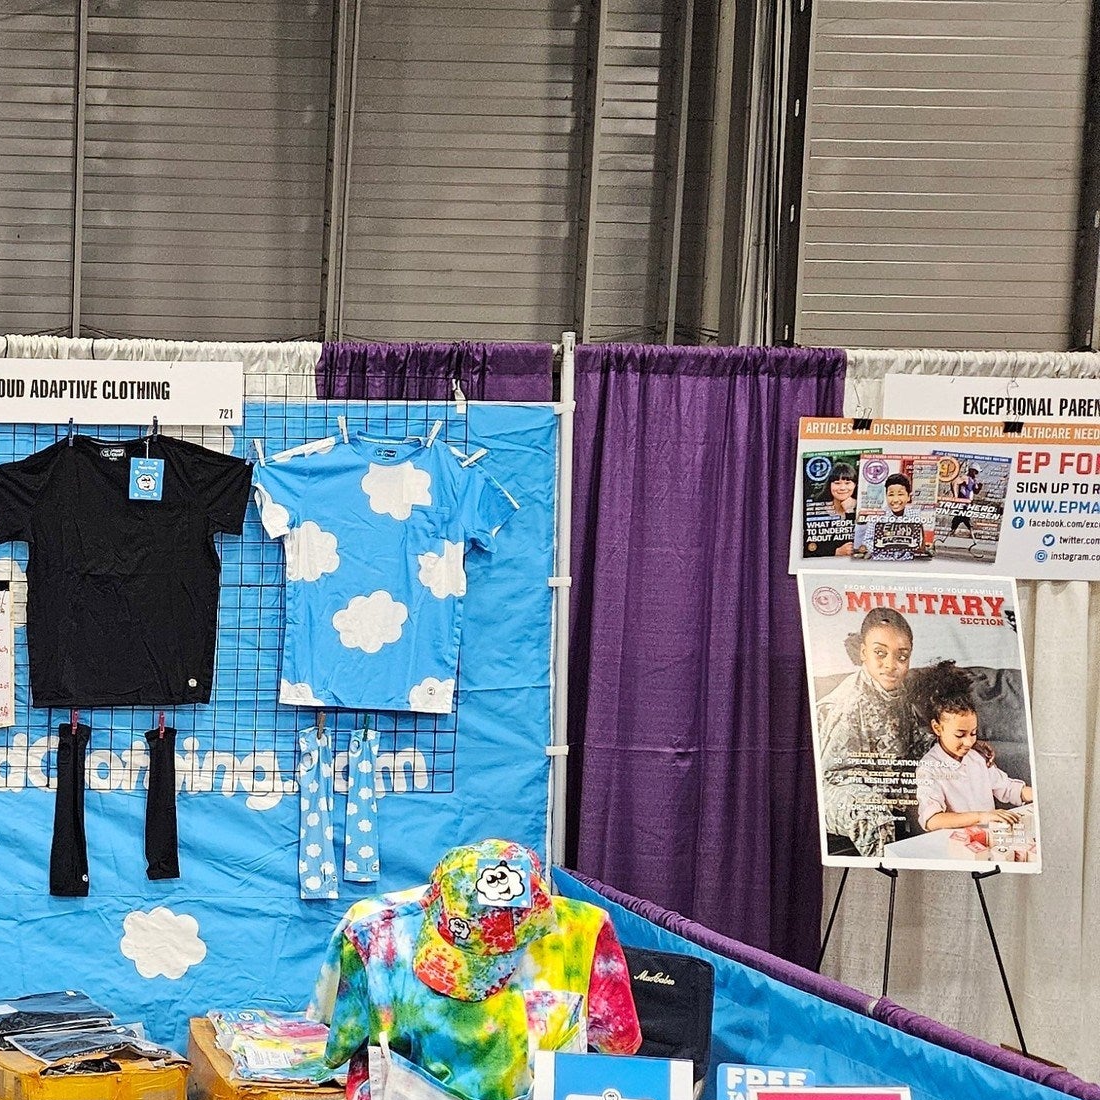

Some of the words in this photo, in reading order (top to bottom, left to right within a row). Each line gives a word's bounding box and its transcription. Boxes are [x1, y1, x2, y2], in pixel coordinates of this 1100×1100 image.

[30, 379, 98, 400] ADAPTIVE
[102, 380, 171, 401] CLOTHING
[962, 396, 1054, 416] EXCEPTIONAL
[219, 408, 233, 420] 721
[806, 423, 854, 435] ARTICLES
[873, 423, 937, 437] DISABILITIES
[940, 426, 960, 438] AND
[963, 426, 1004, 439] SPECIAL
[1016, 451, 1051, 474] EP
[1016, 482, 1047, 494] SIGN
[1051, 483, 1070, 494] UP
[1072, 483, 1089, 495] TO
[938, 501, 967, 510] TRUE
[806, 521, 830, 529] WHAT
[860, 516, 884, 524] BACK
[845, 591, 1005, 617] MILITARY
[960, 617, 1004, 627] SECTION
[847, 758, 876, 766] SPECIAL
[864, 777, 899, 785] RESILIENT
